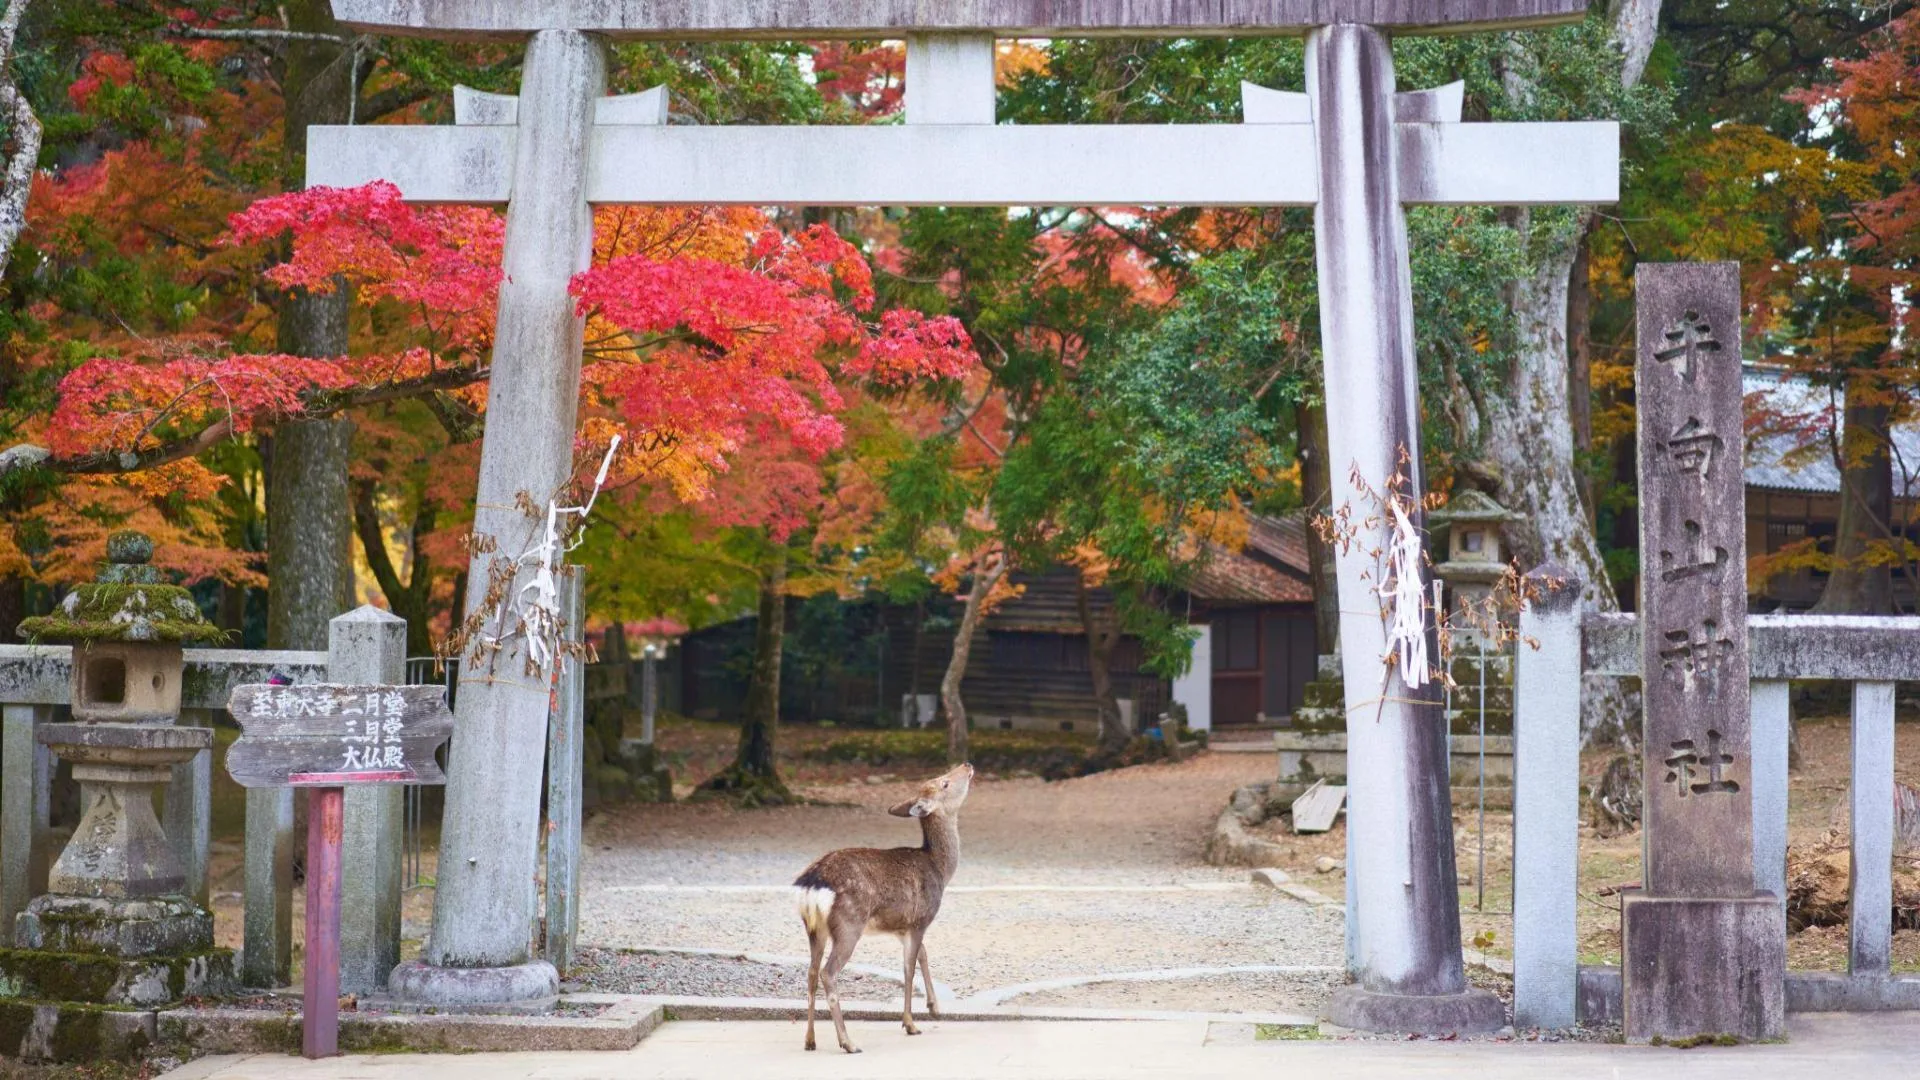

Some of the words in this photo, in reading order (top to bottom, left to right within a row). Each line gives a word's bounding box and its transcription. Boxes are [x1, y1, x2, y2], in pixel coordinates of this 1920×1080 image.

[1653, 310, 1740, 798] 手向山神社
[341, 717, 405, 745] 三月堂
[341, 745, 406, 769] 大仏殿
